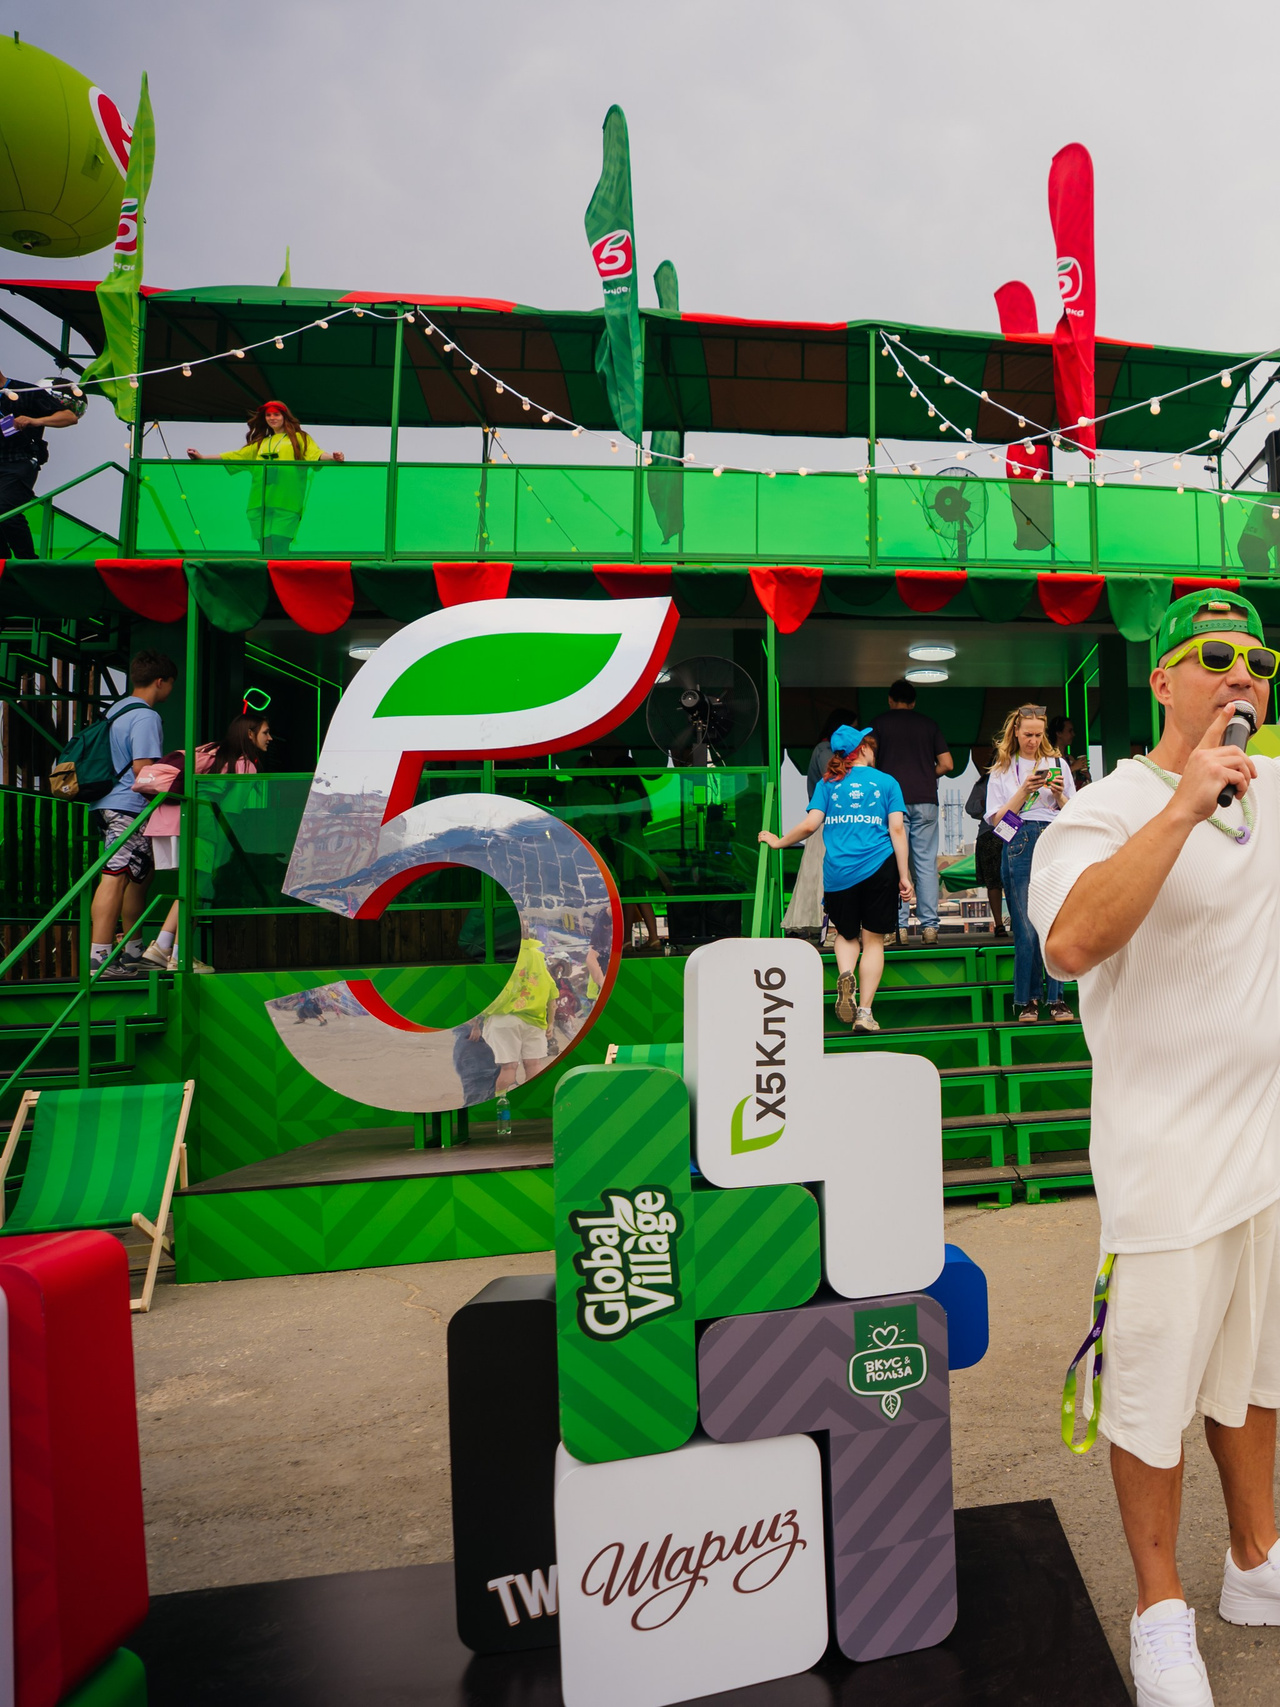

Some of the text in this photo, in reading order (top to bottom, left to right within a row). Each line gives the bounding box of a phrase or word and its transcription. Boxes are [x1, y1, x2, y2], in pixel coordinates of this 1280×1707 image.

[264, 596, 681, 1113] 5
[577, 1196, 632, 1335] Global
[628, 1191, 677, 1324] Village
[864, 1356, 911, 1373] ВКУС &
[866, 1366, 913, 1383] ПОЛЬЗА
